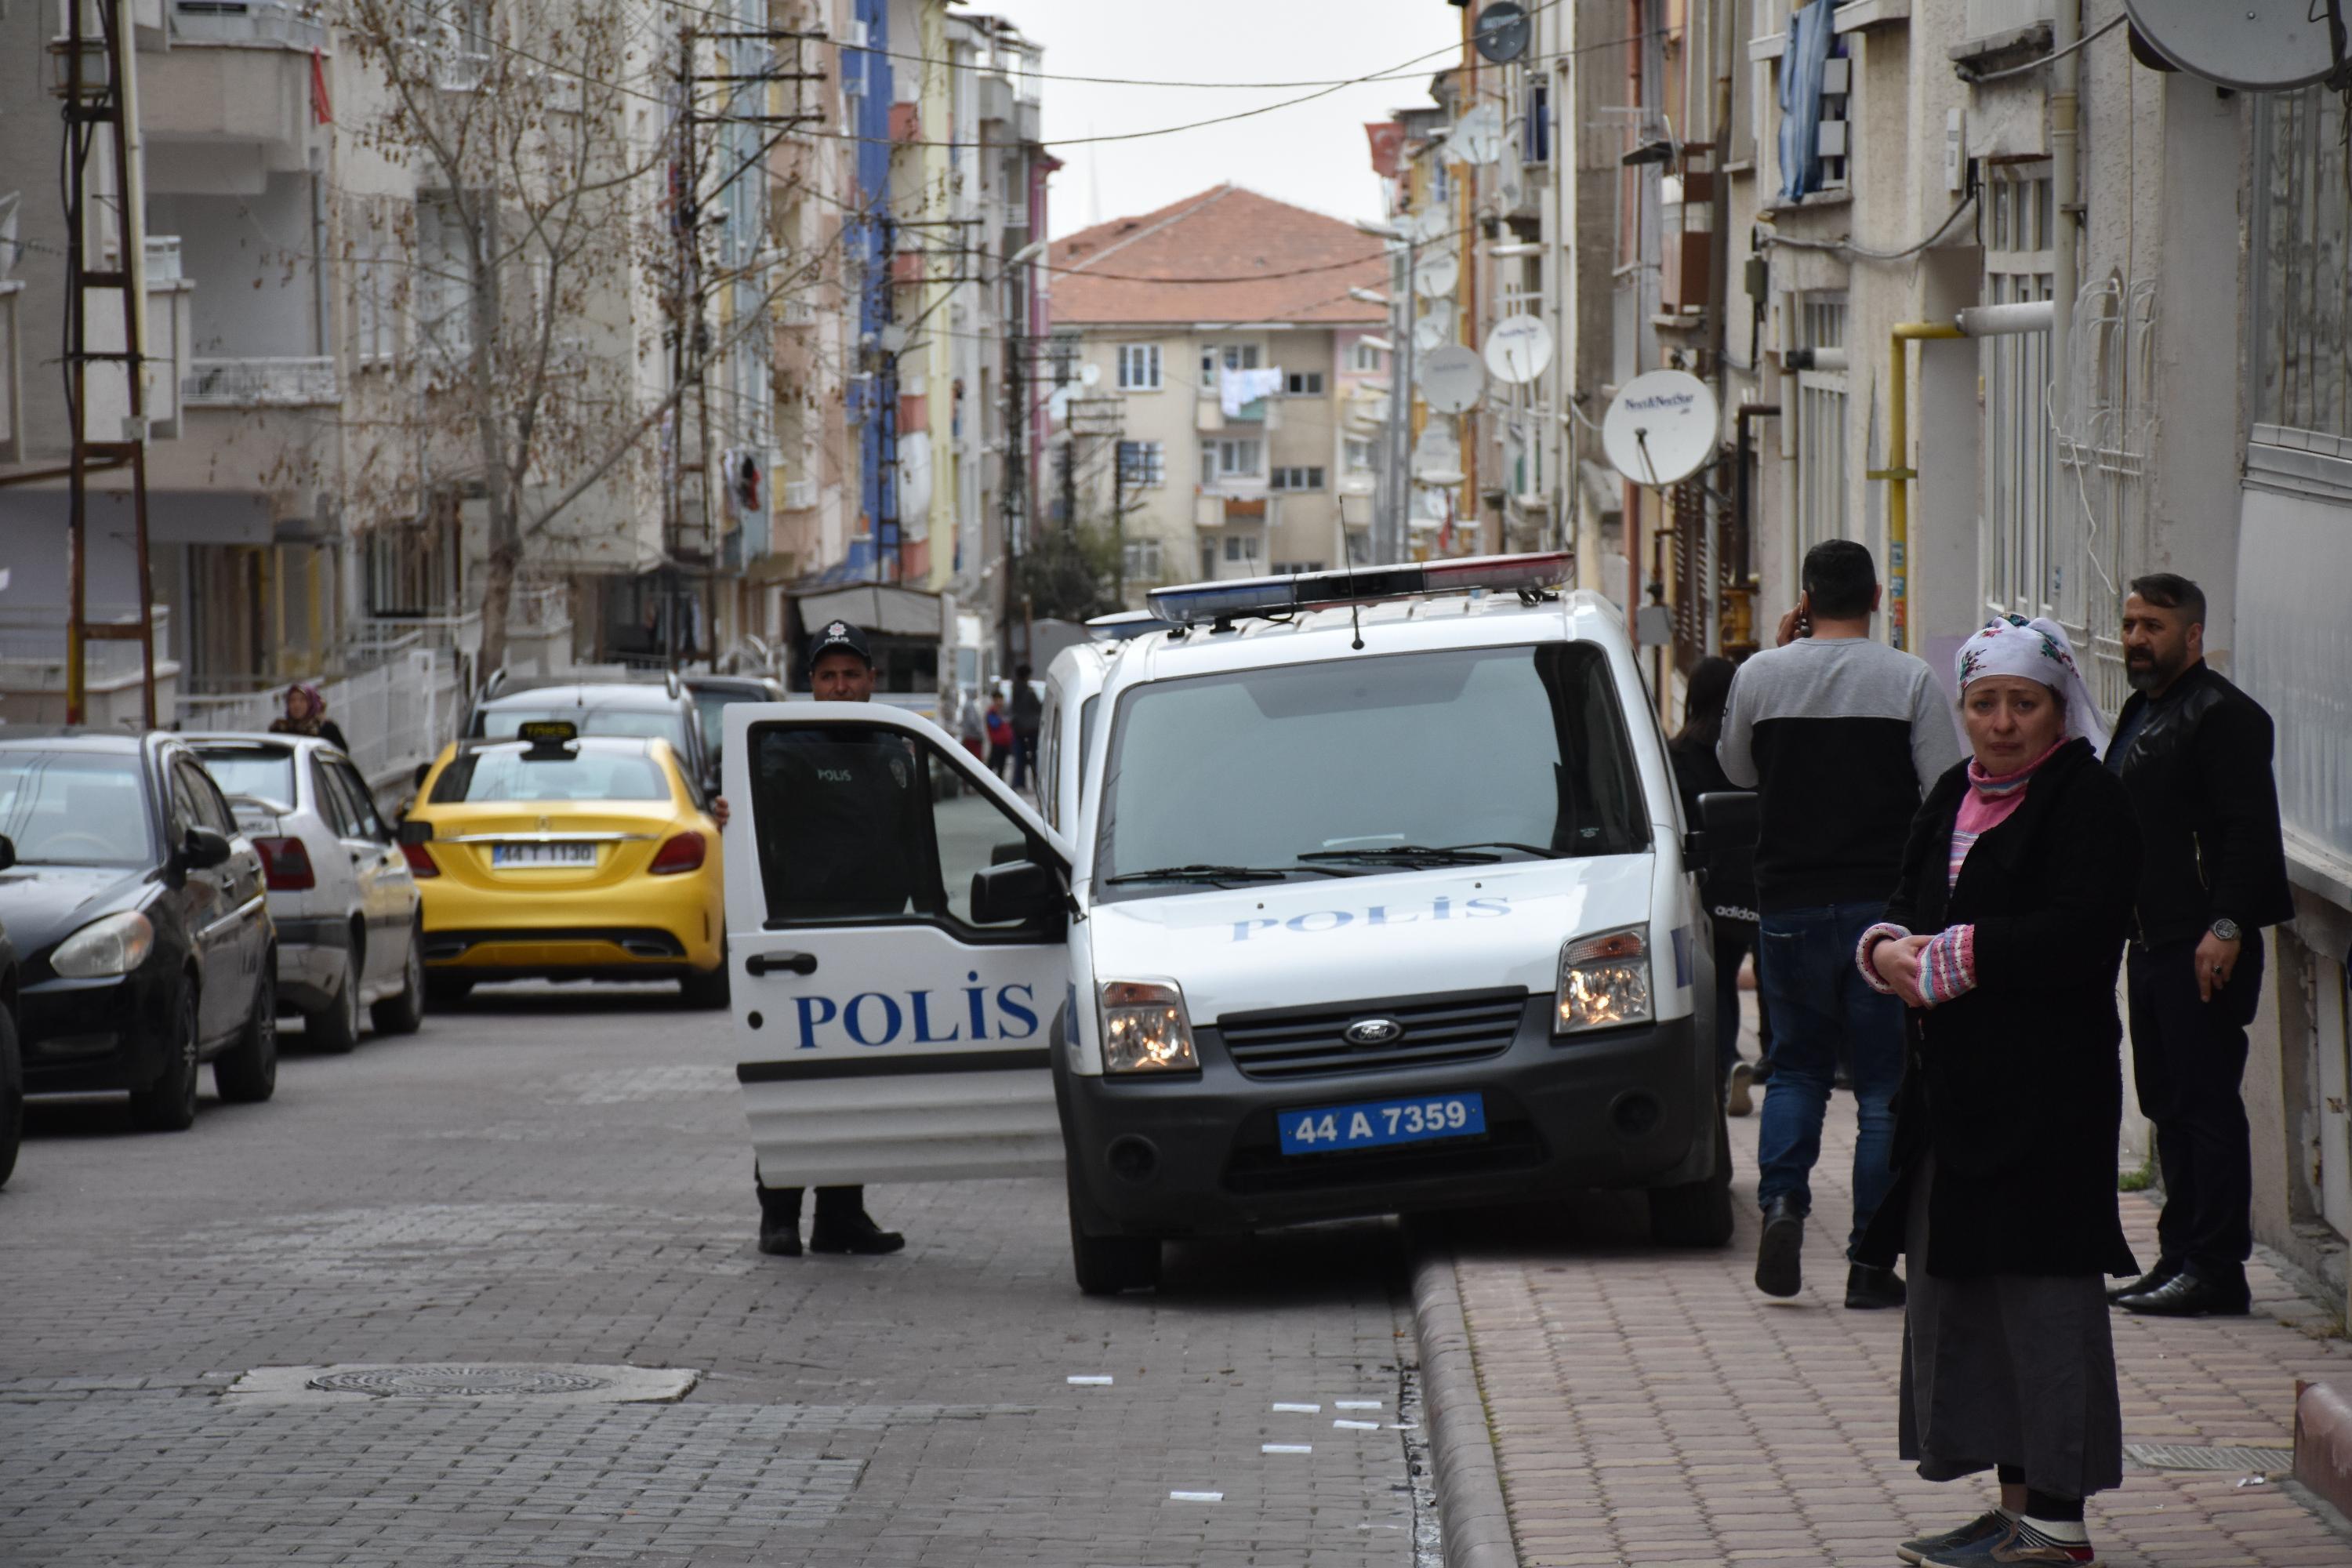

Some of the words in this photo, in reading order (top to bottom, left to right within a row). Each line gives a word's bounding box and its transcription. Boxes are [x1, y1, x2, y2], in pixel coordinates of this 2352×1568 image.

[503, 844, 522, 861] 44
[529, 844, 539, 860] T
[550, 844, 591, 860] 1130
[1228, 895, 1512, 942] POLİS
[789, 970, 1039, 1049] POLİS
[1357, 1026, 1388, 1040] Ford
[1295, 1114, 1338, 1144] 44
[1348, 1111, 1374, 1140] A
[1382, 1101, 1467, 1136] 7359
